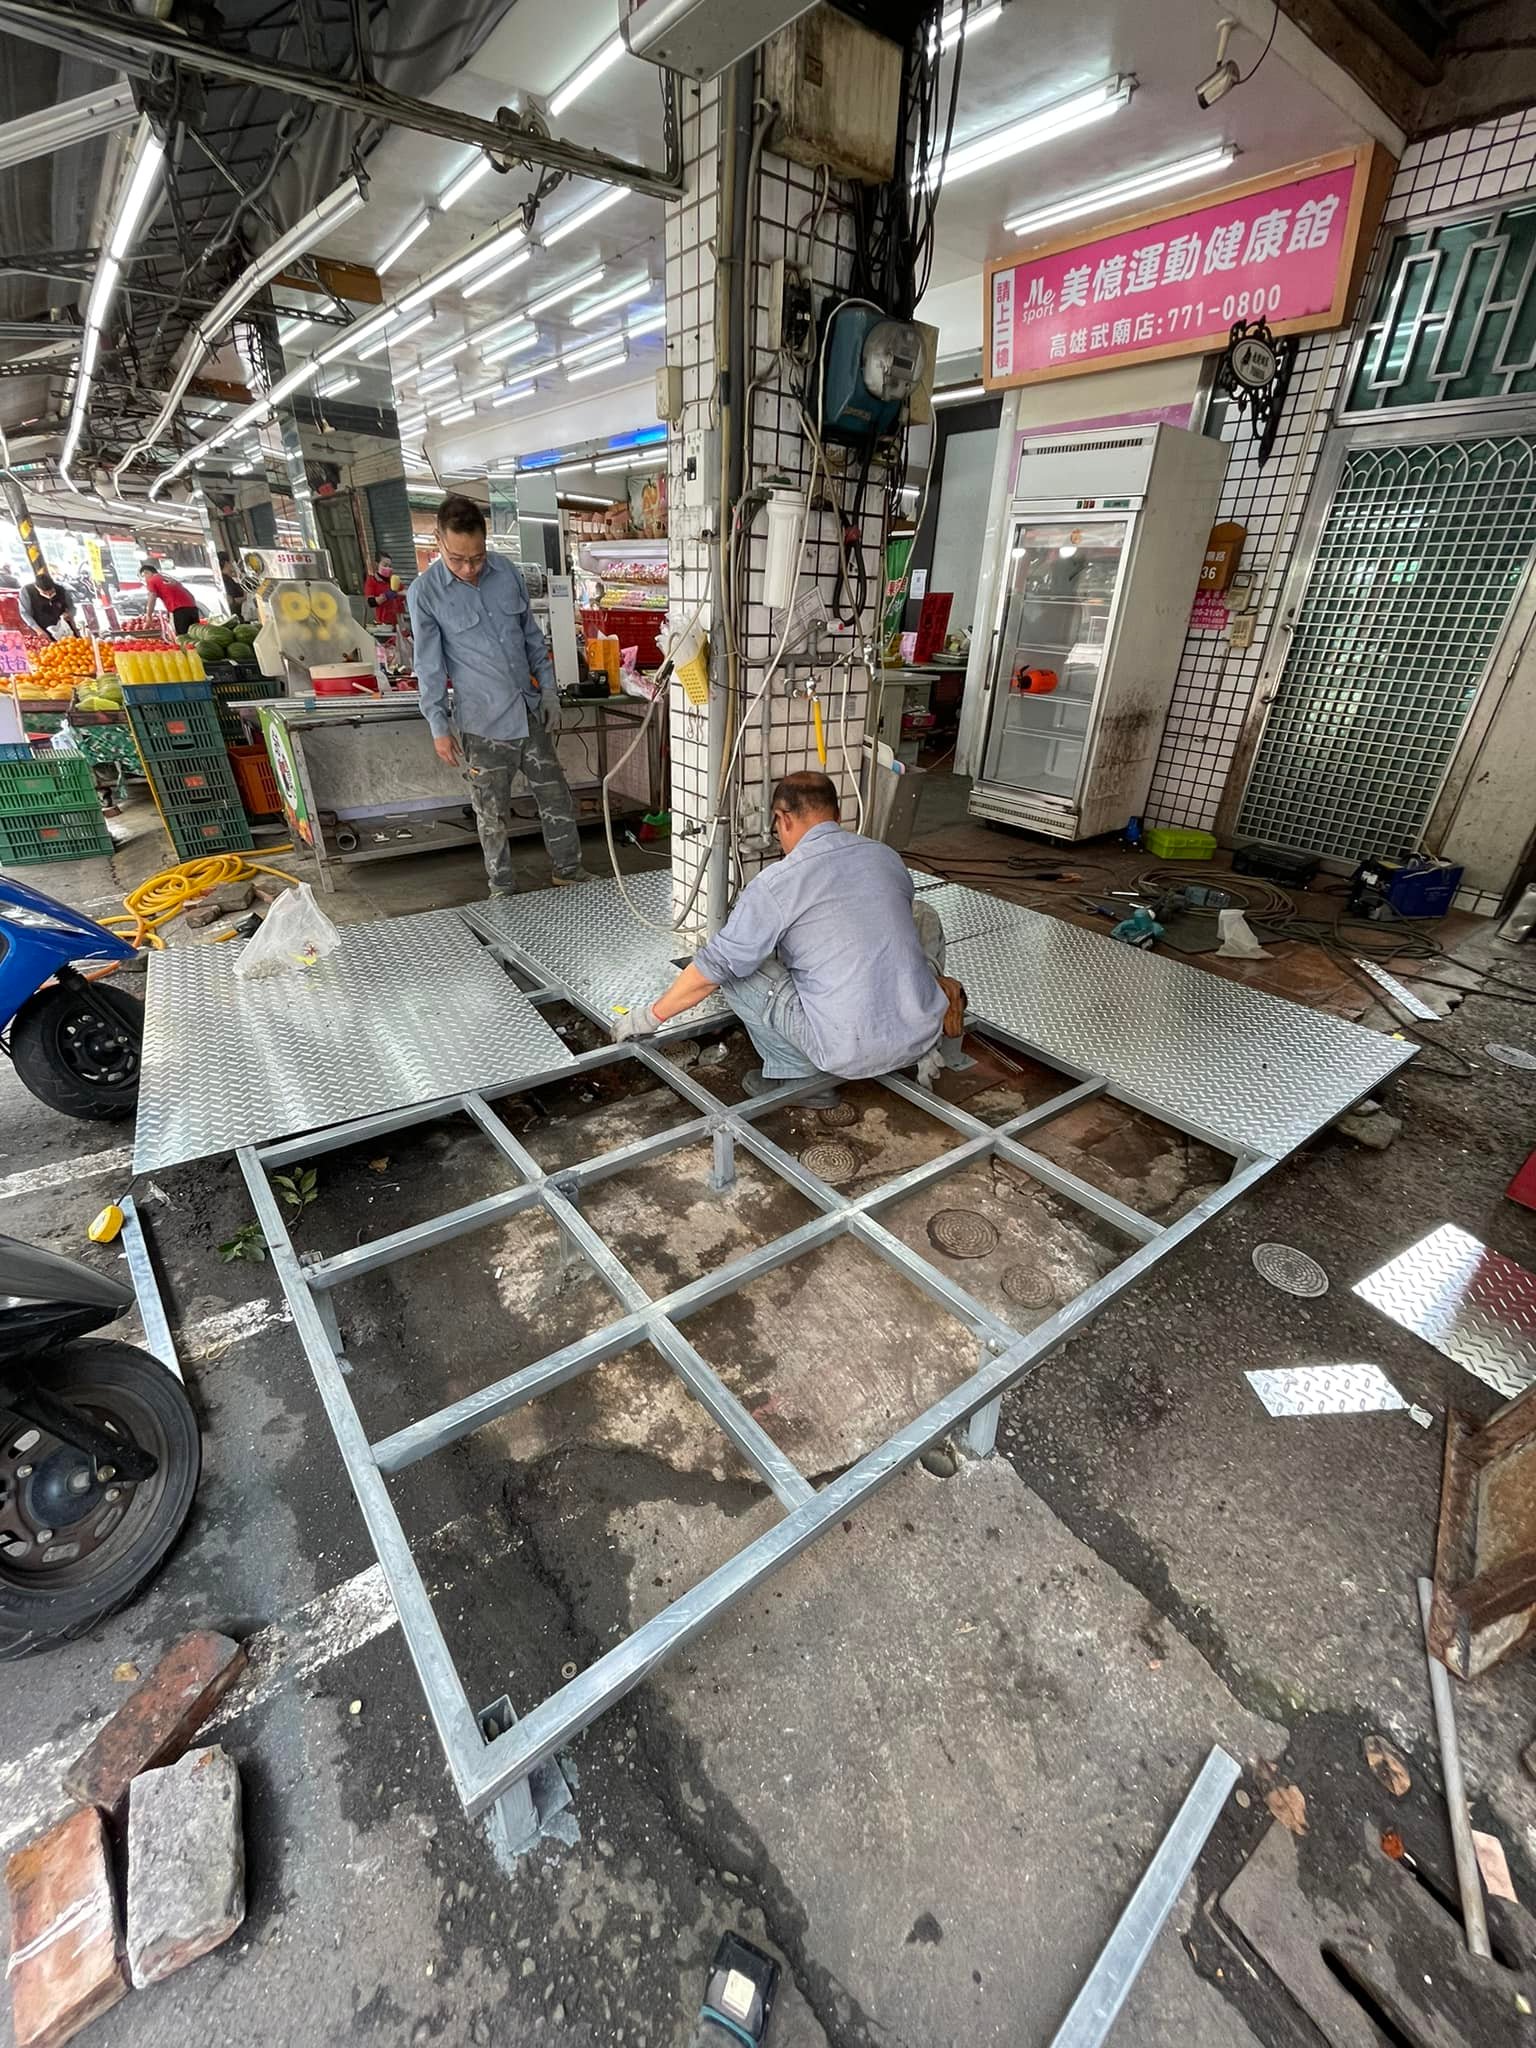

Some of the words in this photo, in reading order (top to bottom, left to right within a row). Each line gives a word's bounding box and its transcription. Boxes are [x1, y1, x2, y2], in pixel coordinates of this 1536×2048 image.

[1059, 194, 1340, 313] 美憶運動健康館
[1022, 303, 1055, 326] sport
